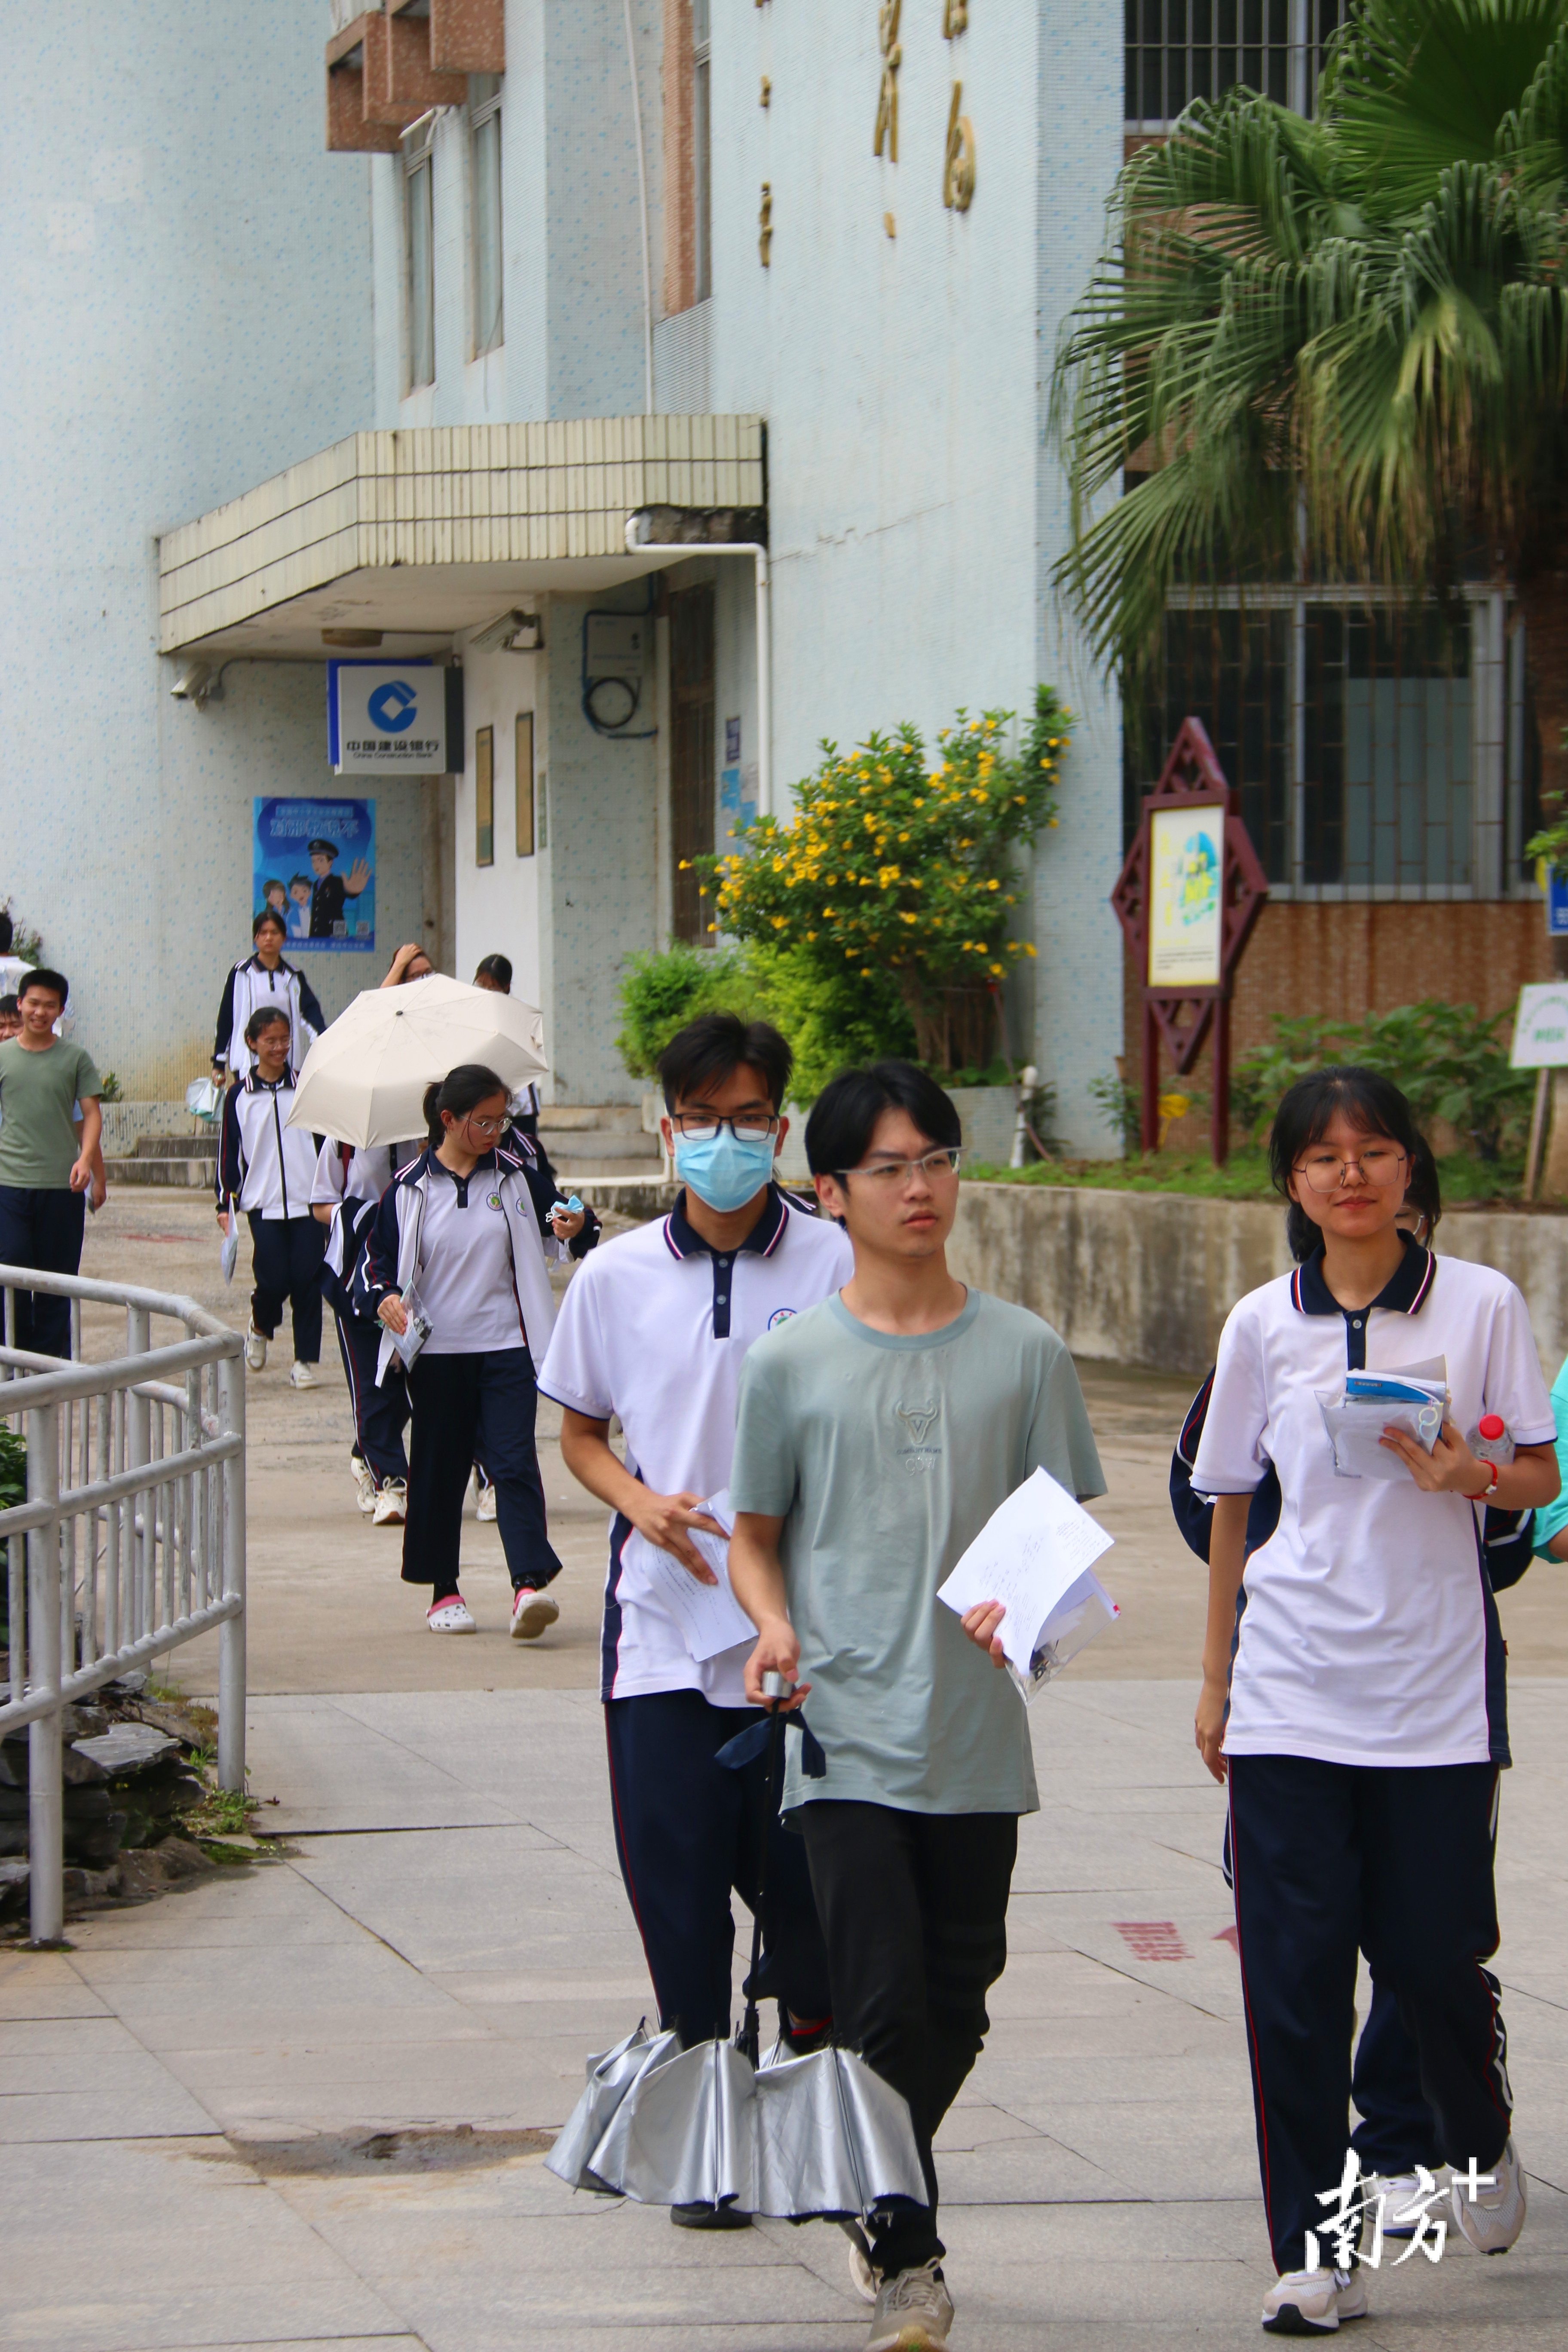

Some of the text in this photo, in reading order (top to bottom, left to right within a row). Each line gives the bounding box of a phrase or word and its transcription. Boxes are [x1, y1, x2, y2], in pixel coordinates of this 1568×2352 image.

[346, 740, 438, 751] 中国建设银行
[912, 1420, 923, 1432] V
